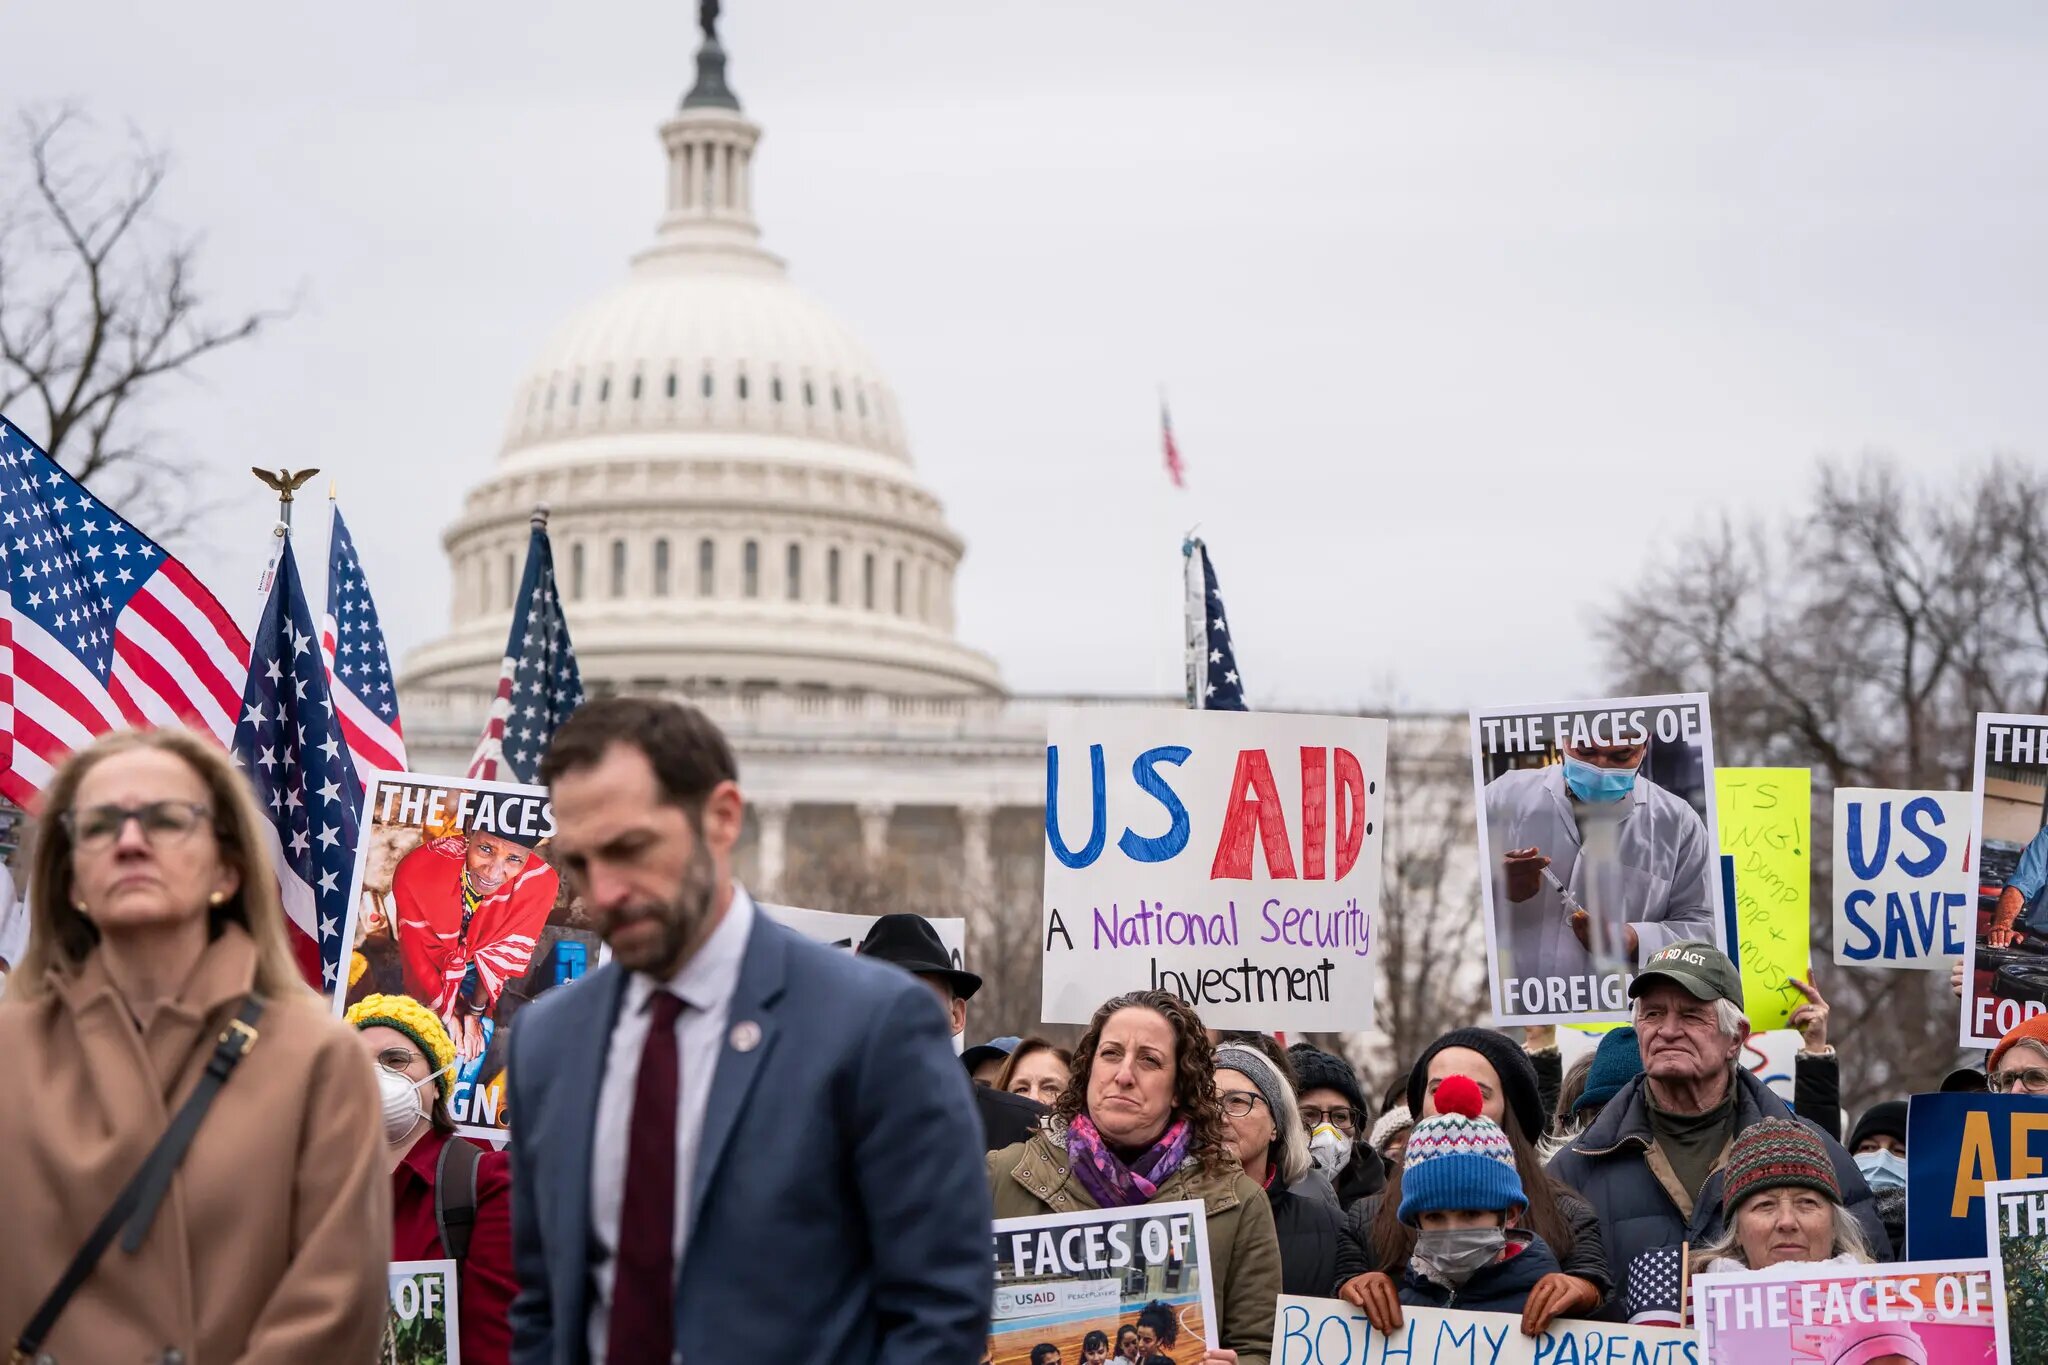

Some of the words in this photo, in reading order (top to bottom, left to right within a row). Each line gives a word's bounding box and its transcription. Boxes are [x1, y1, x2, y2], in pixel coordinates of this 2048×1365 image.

[1482, 717, 1545, 754] THE
[1553, 709, 1649, 750] FACES
[1656, 706, 1701, 743] OF
[378, 783, 448, 828] THE
[455, 792, 560, 838] FACES
[1846, 796, 1948, 881] US
[1046, 908, 1074, 952] A
[1093, 899, 1239, 950] National
[1260, 897, 1371, 957] Security
[1150, 957, 1335, 1006] Investment
[1681, 950, 1706, 966] ACT
[1012, 1223, 1131, 1278] FACES
[1140, 1217, 1192, 1265] OF
[394, 1276, 441, 1321] OF
[1015, 1291, 1056, 1306] USAID
[1708, 1285, 1790, 1331] THE
[1800, 1277, 1925, 1327] FACES
[1934, 1274, 1988, 1320] OF
[1282, 1305, 1416, 1365] BOTH
[1433, 1318, 1510, 1365] MY
